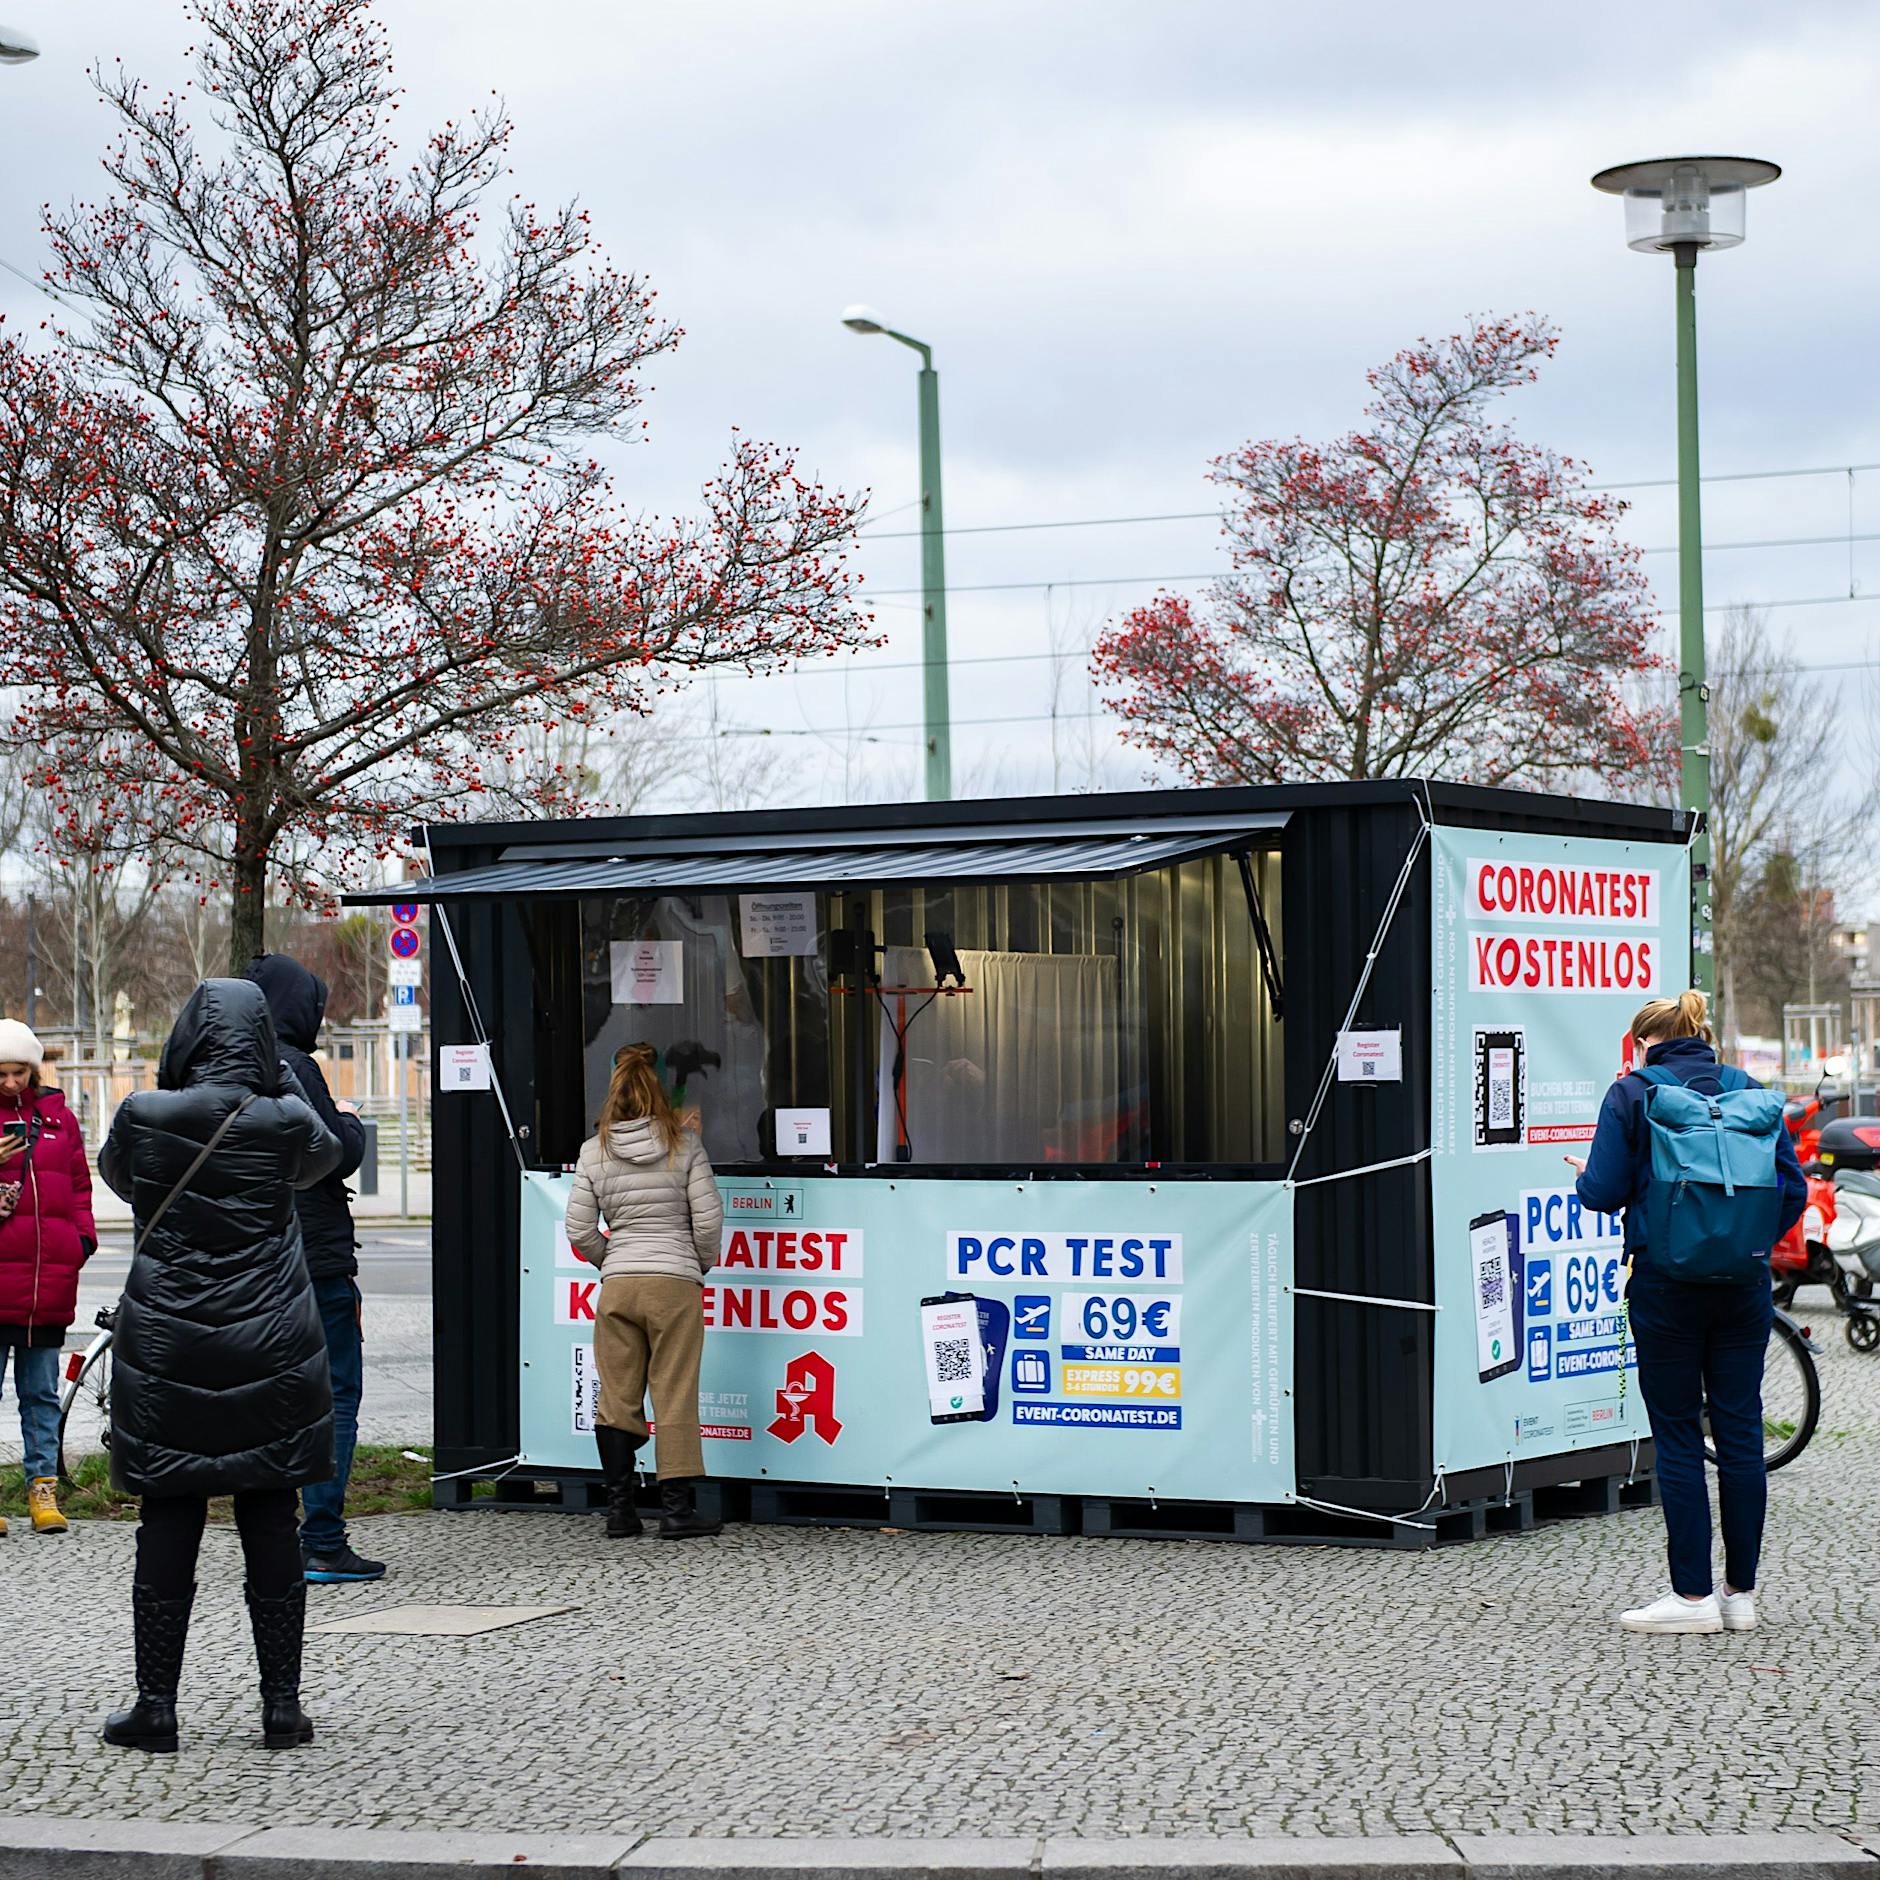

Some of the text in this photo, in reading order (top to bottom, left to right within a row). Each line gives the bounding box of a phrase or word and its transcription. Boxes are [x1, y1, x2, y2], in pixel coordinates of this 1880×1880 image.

[1436, 854, 1446, 889] UND
[1478, 864, 1650, 918] CORONATEST
[1436, 893, 1446, 980] GEPRÜFTEN
[1448, 931, 1456, 963] VON
[1476, 936, 1651, 989] KOSTENLOS
[1437, 982, 1446, 1010] MIT
[1448, 966, 1456, 1050] PRODUKTEN
[1436, 1013, 1446, 1088] BELIEFERT
[732, 1197, 772, 1209] BERLIN
[1527, 1194, 1583, 1244] PCR
[958, 1237, 1172, 1278] PCR TEST
[1566, 1256, 1619, 1314] 69€
[569, 1281, 848, 1331] KENLOS
[937, 1313, 961, 1321] REGISTER
[1083, 1296, 1171, 1340] 69€
[1250, 1232, 1261, 1405] ZERTIFIZIERTEN PRODUKTEN VON
[932, 1321, 967, 1331] CORONATEST
[1569, 1318, 1615, 1339] SAME DAY
[1085, 1346, 1157, 1361] SAME DAY
[1267, 1232, 1280, 1465] TÄGLICH BELIEFERT MIT GEPRÜFTEN UND
[1066, 1369, 1120, 1382] EXPRESS
[1081, 1382, 1120, 1392] STUNDEN
[1124, 1370, 1176, 1395] 99€
[710, 1407, 748, 1419] TERMIN
[717, 1393, 748, 1406] JETZT
[1016, 1406, 1178, 1425] EVENT-CORONATEST.DE
[1592, 1408, 1613, 1422] BERLIN
